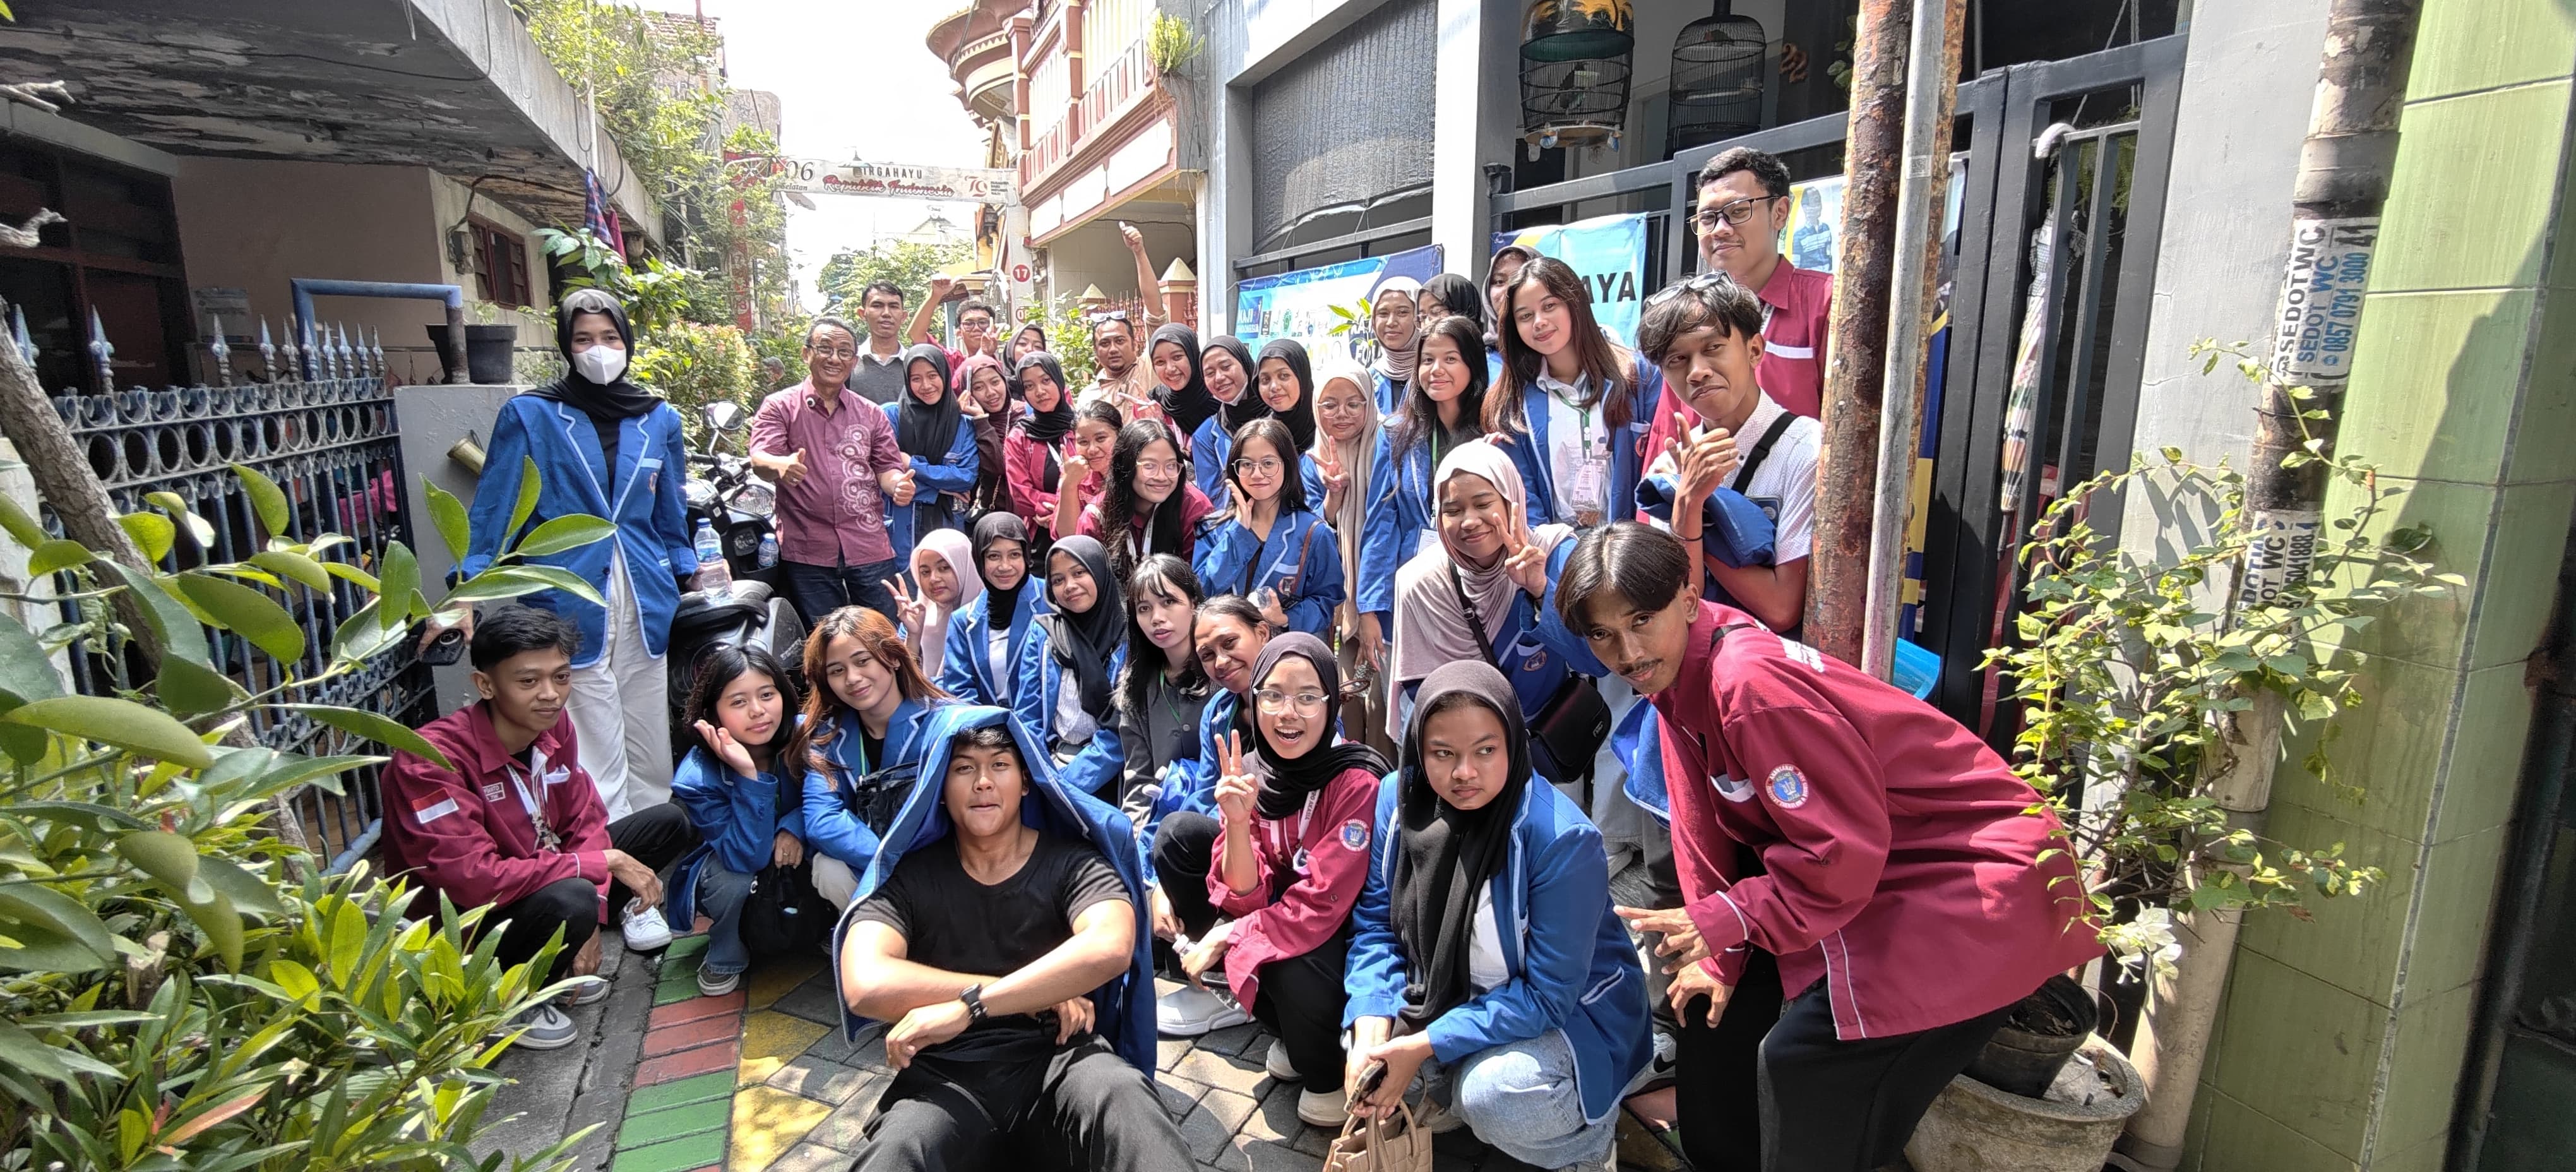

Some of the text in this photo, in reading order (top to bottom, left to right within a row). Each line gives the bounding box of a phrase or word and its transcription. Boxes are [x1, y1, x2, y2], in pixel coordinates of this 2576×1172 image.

[859, 166, 922, 179] IRGAHAYU
[888, 179, 955, 197] Indonesia
[1015, 268, 1028, 278] 17
[2297, 255, 2339, 362] SEDOT WC
[2322, 253, 2370, 352] 0857 0791 3000
[2262, 537, 2286, 569] WC
